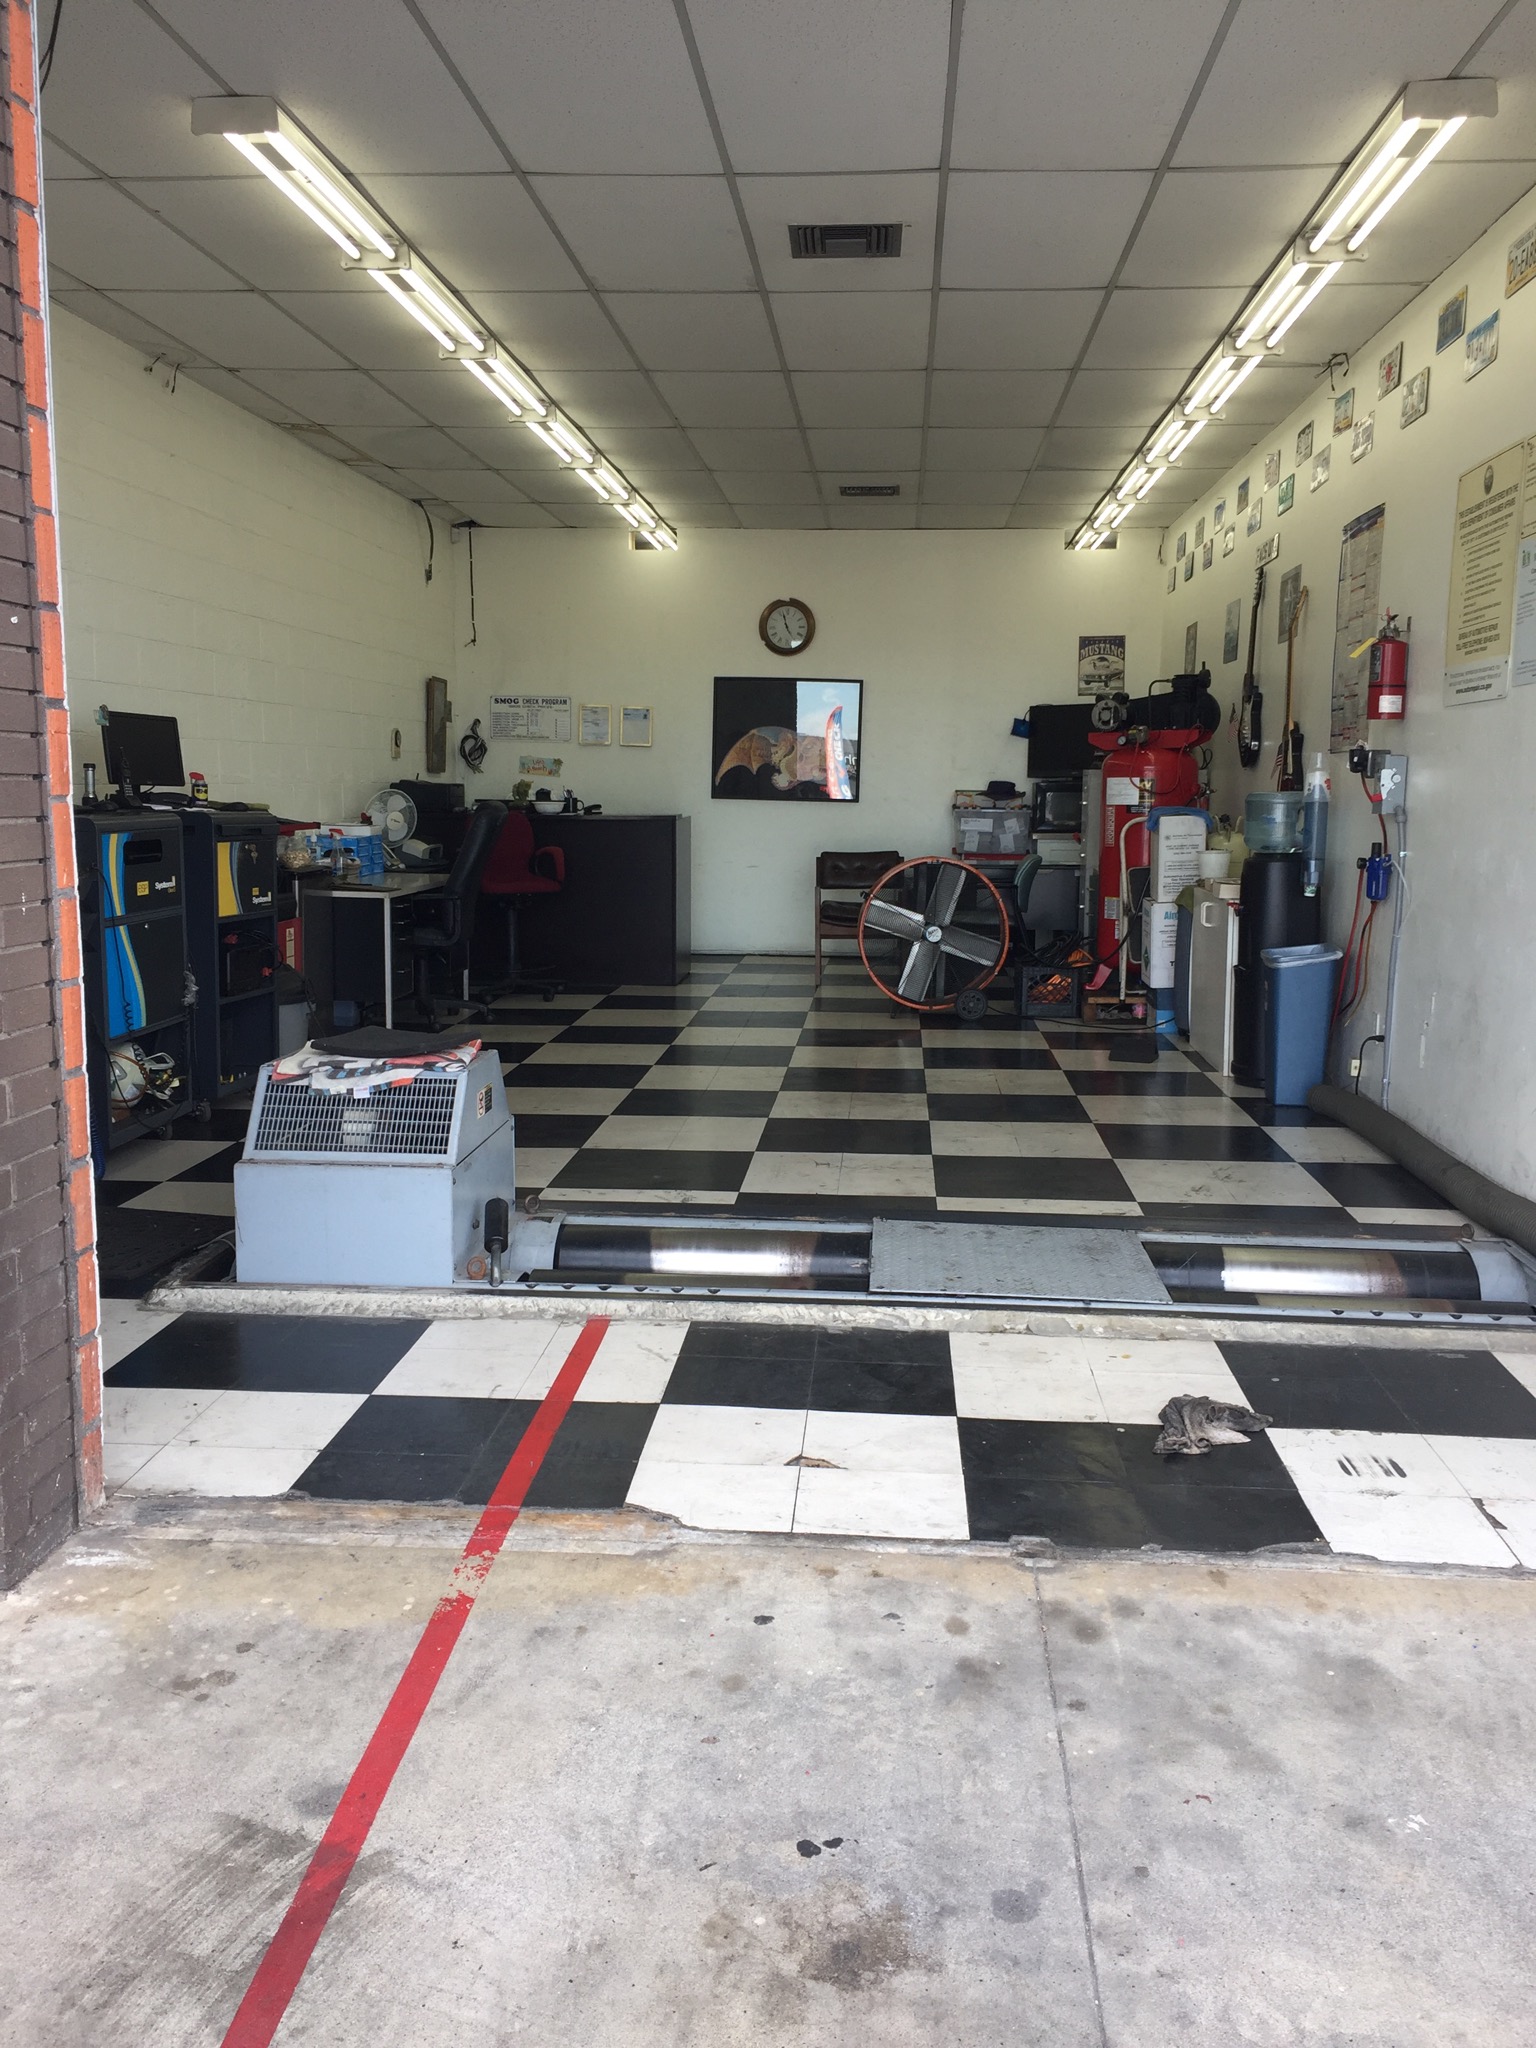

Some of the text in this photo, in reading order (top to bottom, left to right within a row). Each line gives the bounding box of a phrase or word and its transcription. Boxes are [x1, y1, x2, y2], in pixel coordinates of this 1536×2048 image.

[1080, 644, 1124, 660] MUSTANG
[494, 697, 519, 705] SMOG
[542, 698, 568, 706] PROGRAM
